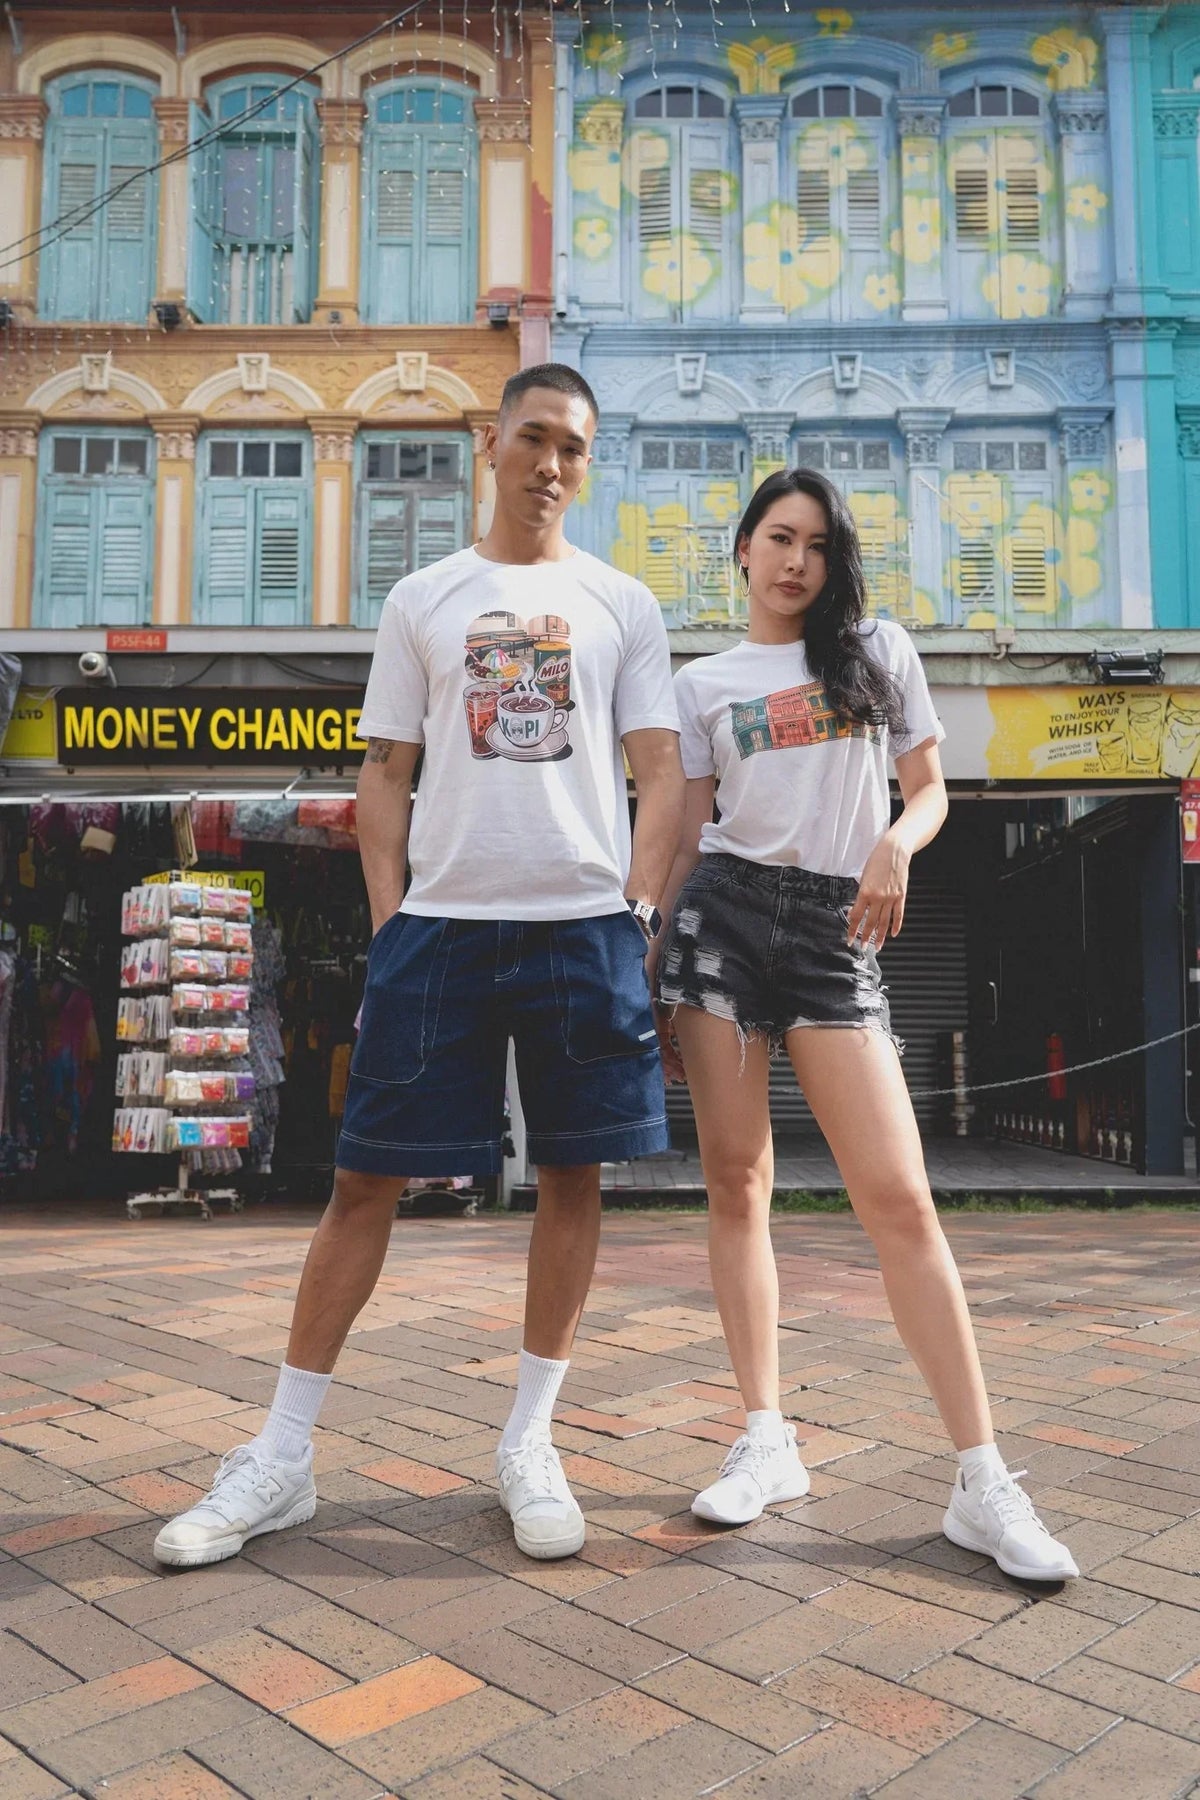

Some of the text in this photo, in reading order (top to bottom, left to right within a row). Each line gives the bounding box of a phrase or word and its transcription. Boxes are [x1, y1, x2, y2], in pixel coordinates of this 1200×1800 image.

[541, 662, 569, 678] MILO
[1078, 691, 1126, 709] WAYS
[18, 709, 44, 720] LTD
[1050, 707, 1120, 723] TO ENJOY YOUR
[64, 706, 202, 749] MONEY
[1048, 718, 1116, 740] WHISKY
[209, 873, 225, 887] 10
